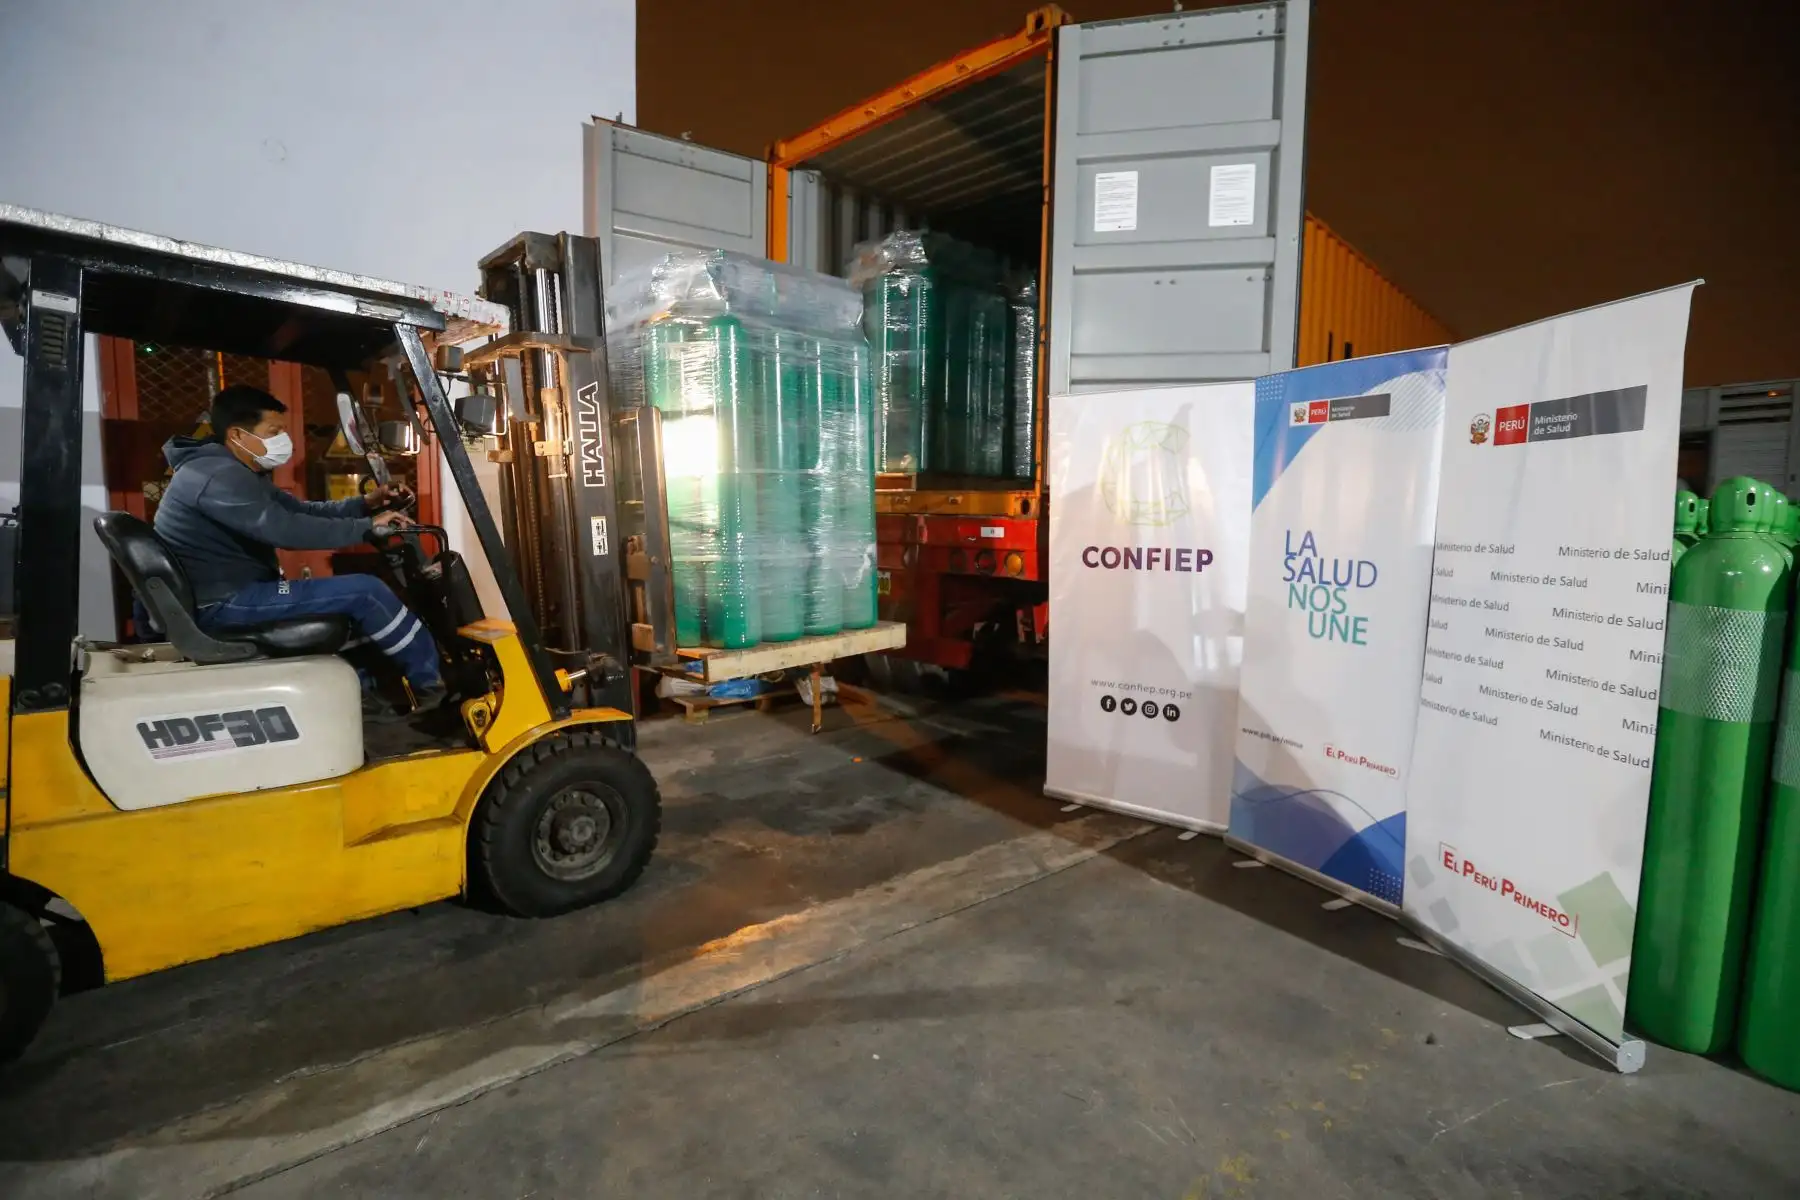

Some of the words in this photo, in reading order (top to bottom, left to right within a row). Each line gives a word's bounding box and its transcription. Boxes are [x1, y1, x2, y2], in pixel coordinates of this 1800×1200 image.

[1499, 416, 1525, 432] PERÚ
[1534, 411, 1578, 425] Ministerio
[1534, 427, 1545, 436] de
[1546, 422, 1571, 434] Salud
[1285, 529, 1317, 558] LA
[1474, 544, 1486, 553] de
[1489, 544, 1515, 555] Salud
[1558, 546, 1610, 559] Ministerio
[1614, 548, 1630, 559] de
[1633, 549, 1670, 561] Salud
[1082, 546, 1213, 572] CONFIEP
[1282, 555, 1378, 588] SALUD
[1490, 571, 1539, 584] Ministerio
[1542, 575, 1556, 585] de
[1560, 575, 1588, 588] Salud
[1288, 582, 1347, 614] NOS
[1469, 598, 1482, 609] de
[1484, 600, 1509, 611] Salud
[1308, 611, 1368, 646] UNE
[1552, 607, 1604, 624] Ministerio
[1607, 614, 1623, 626] de
[1627, 616, 1664, 631] Salud
[1485, 627, 1534, 644] Ministerio
[1536, 635, 1550, 646] de
[1553, 637, 1584, 651] Salud
[1464, 653, 1476, 664] de
[1478, 656, 1504, 669] Salud
[1091, 678, 1193, 699] www.confiep.org.pe
[1546, 669, 1599, 688] Ministerio
[1601, 681, 1616, 693] de
[1619, 684, 1657, 700] Salud
[1479, 684, 1528, 704] Ministerio
[1530, 697, 1544, 708] de
[1547, 700, 1578, 716] Salud
[136, 705, 300, 750] HDF30
[1459, 709, 1470, 719] de
[1472, 712, 1498, 726] Salud
[1540, 729, 1595, 753] Ministerio
[1597, 746, 1610, 758] de
[1613, 750, 1650, 769] Salud
